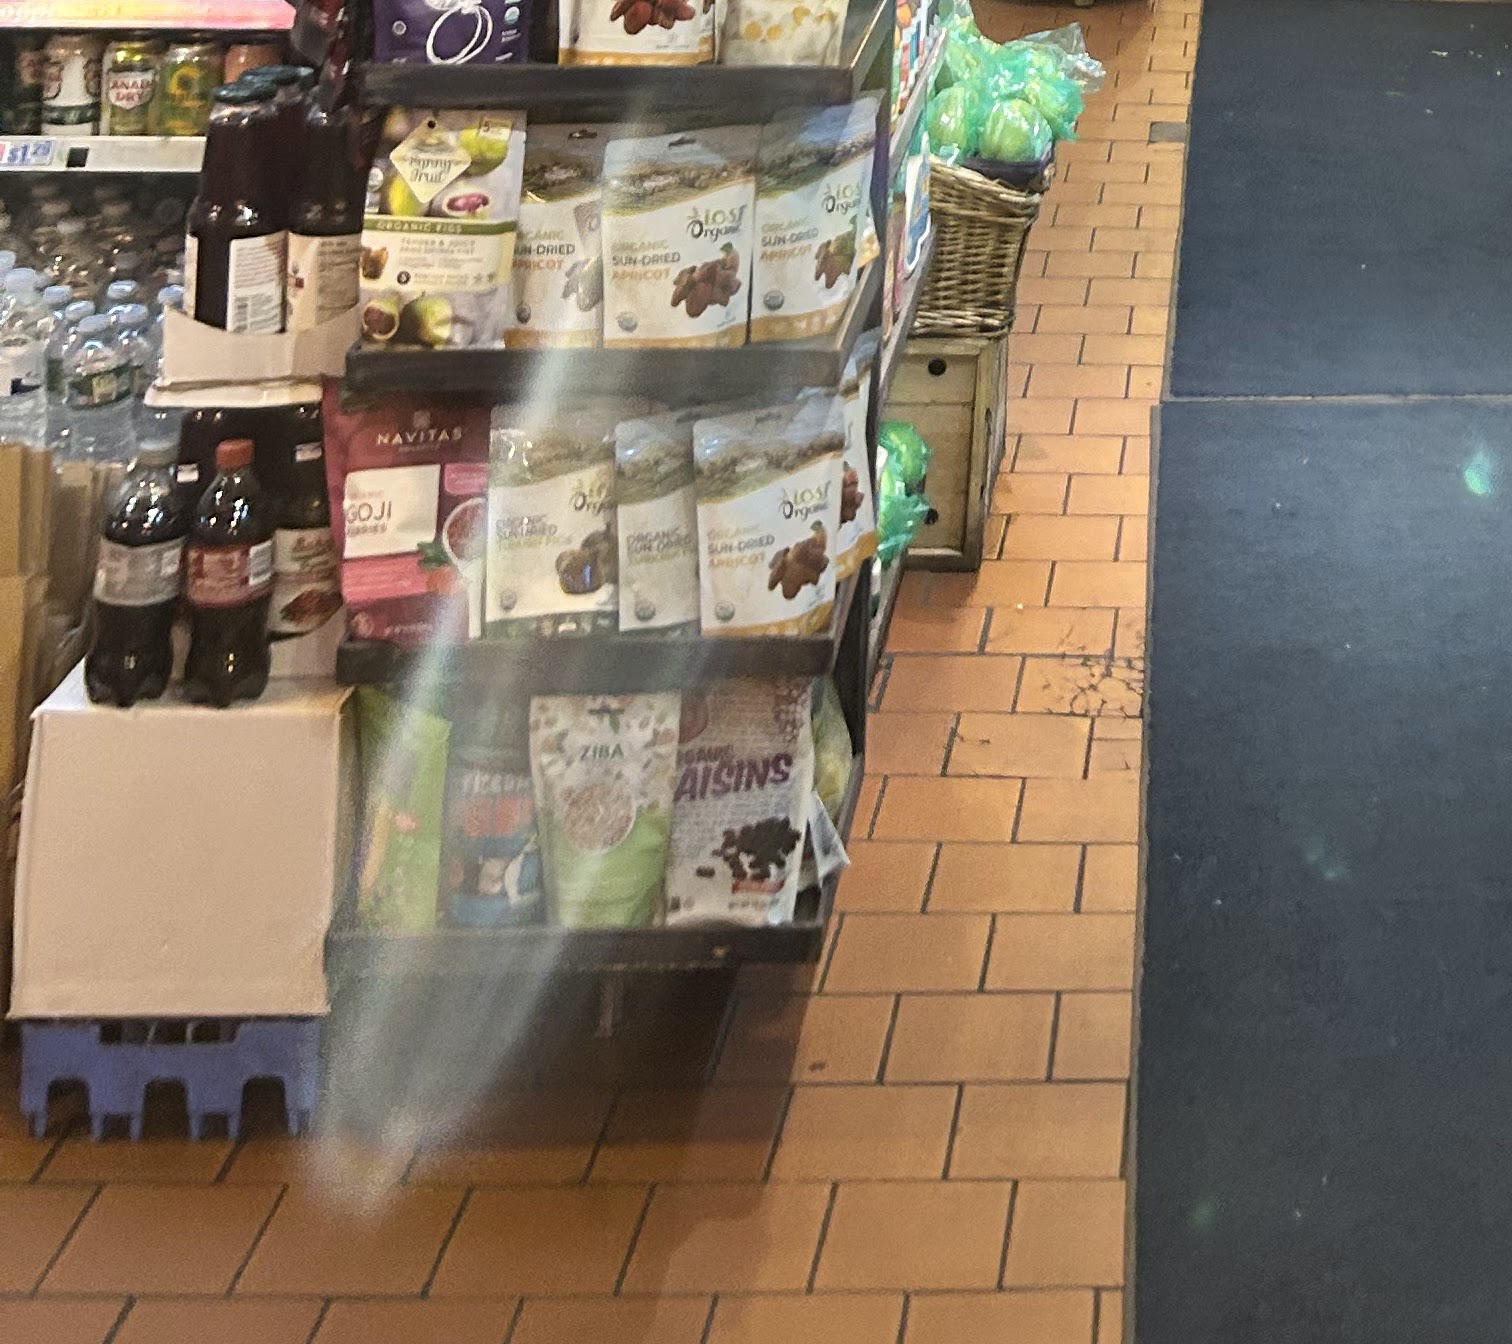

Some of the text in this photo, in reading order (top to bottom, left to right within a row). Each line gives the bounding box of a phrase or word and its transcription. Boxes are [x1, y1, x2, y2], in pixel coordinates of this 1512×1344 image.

[410, 170, 442, 183] Fruit
[377, 221, 431, 232] ORGANIC
[613, 252, 681, 267] SUN-DRIED
[377, 426, 462, 446] NAVITAS
[346, 501, 392, 524] GOJI
[673, 753, 794, 802] AISINS
